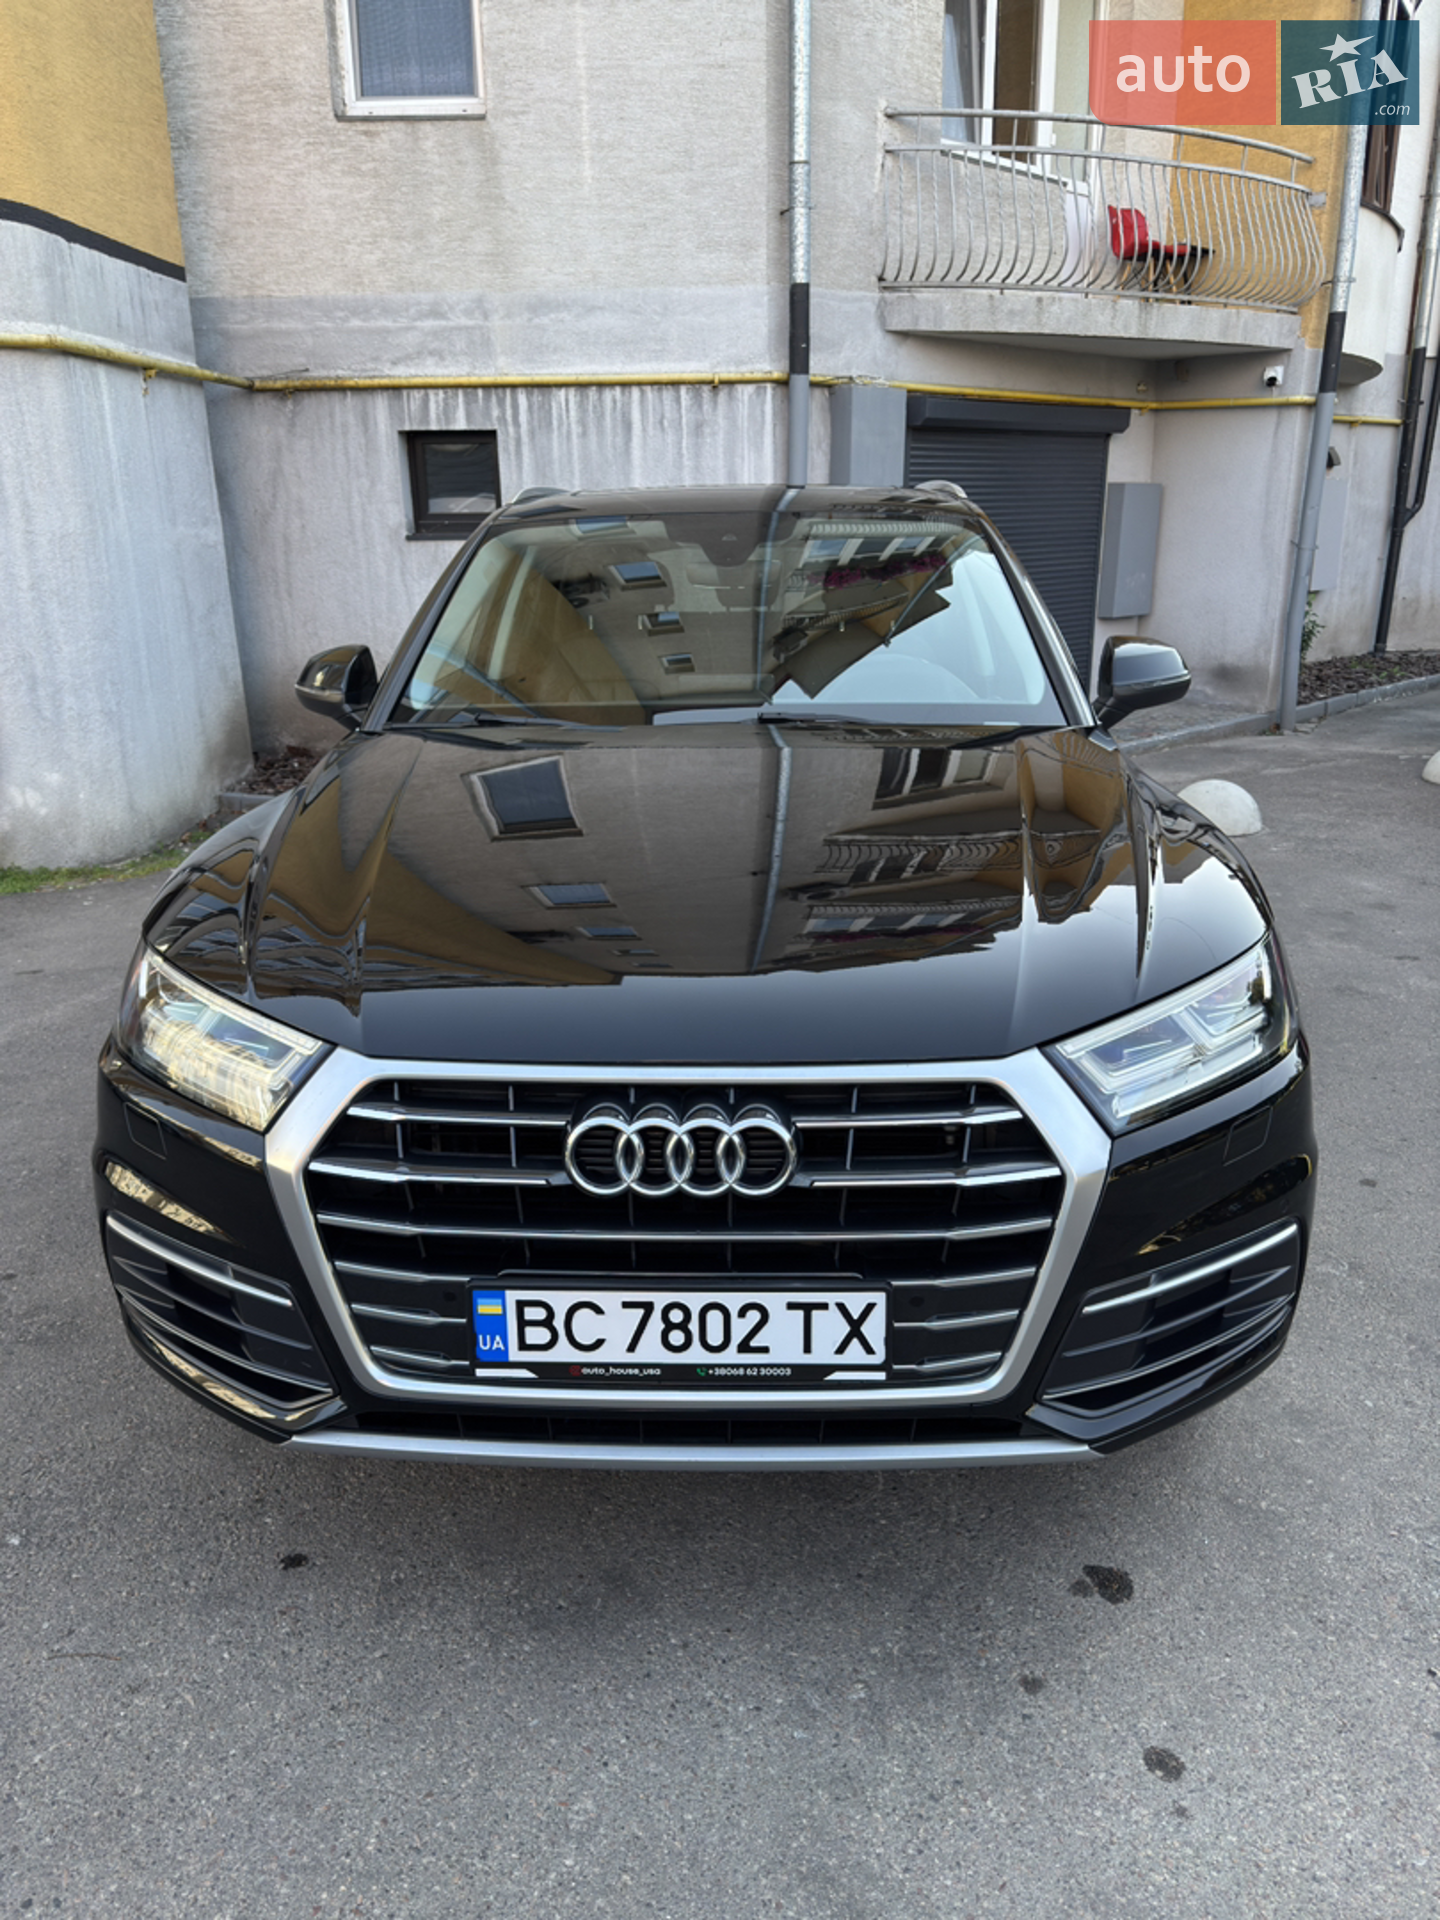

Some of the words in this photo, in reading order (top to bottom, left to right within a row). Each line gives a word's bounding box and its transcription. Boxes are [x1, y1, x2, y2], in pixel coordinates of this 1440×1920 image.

[514, 1299, 606, 1353] BC
[621, 1300, 770, 1354] 7802
[786, 1302, 878, 1355] TX
[478, 1334, 505, 1351] UA
[746, 1367, 758, 1376] 62
[759, 1367, 792, 1376] 30003
